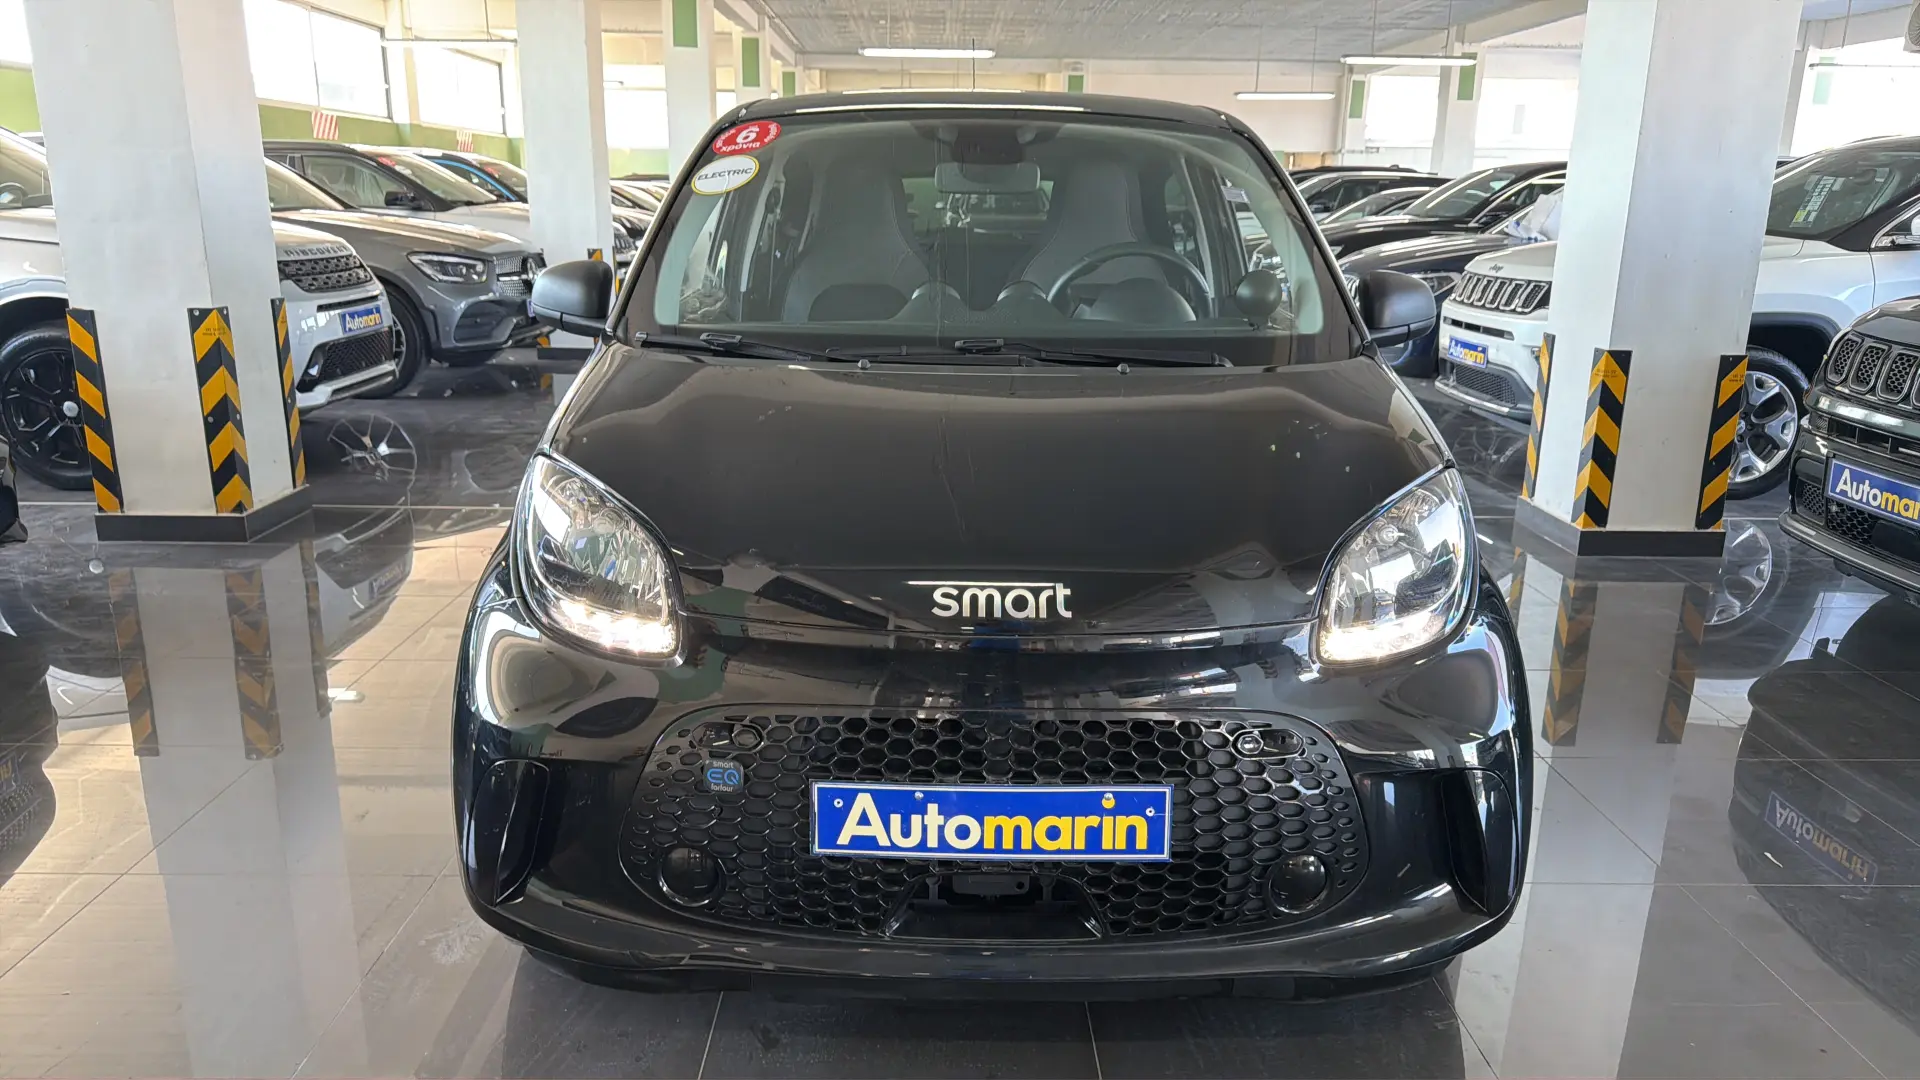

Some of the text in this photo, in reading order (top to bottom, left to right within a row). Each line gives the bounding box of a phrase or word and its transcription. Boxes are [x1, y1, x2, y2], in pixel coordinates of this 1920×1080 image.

[735, 126, 760, 144] 6
[697, 167, 753, 181] ELECTRIC
[345, 307, 382, 332] Automarin
[1448, 339, 1485, 364] Automarin
[931, 582, 1073, 619] smart
[712, 761, 734, 769] smart
[706, 768, 740, 785] EQ
[836, 792, 1148, 851] Automarin
